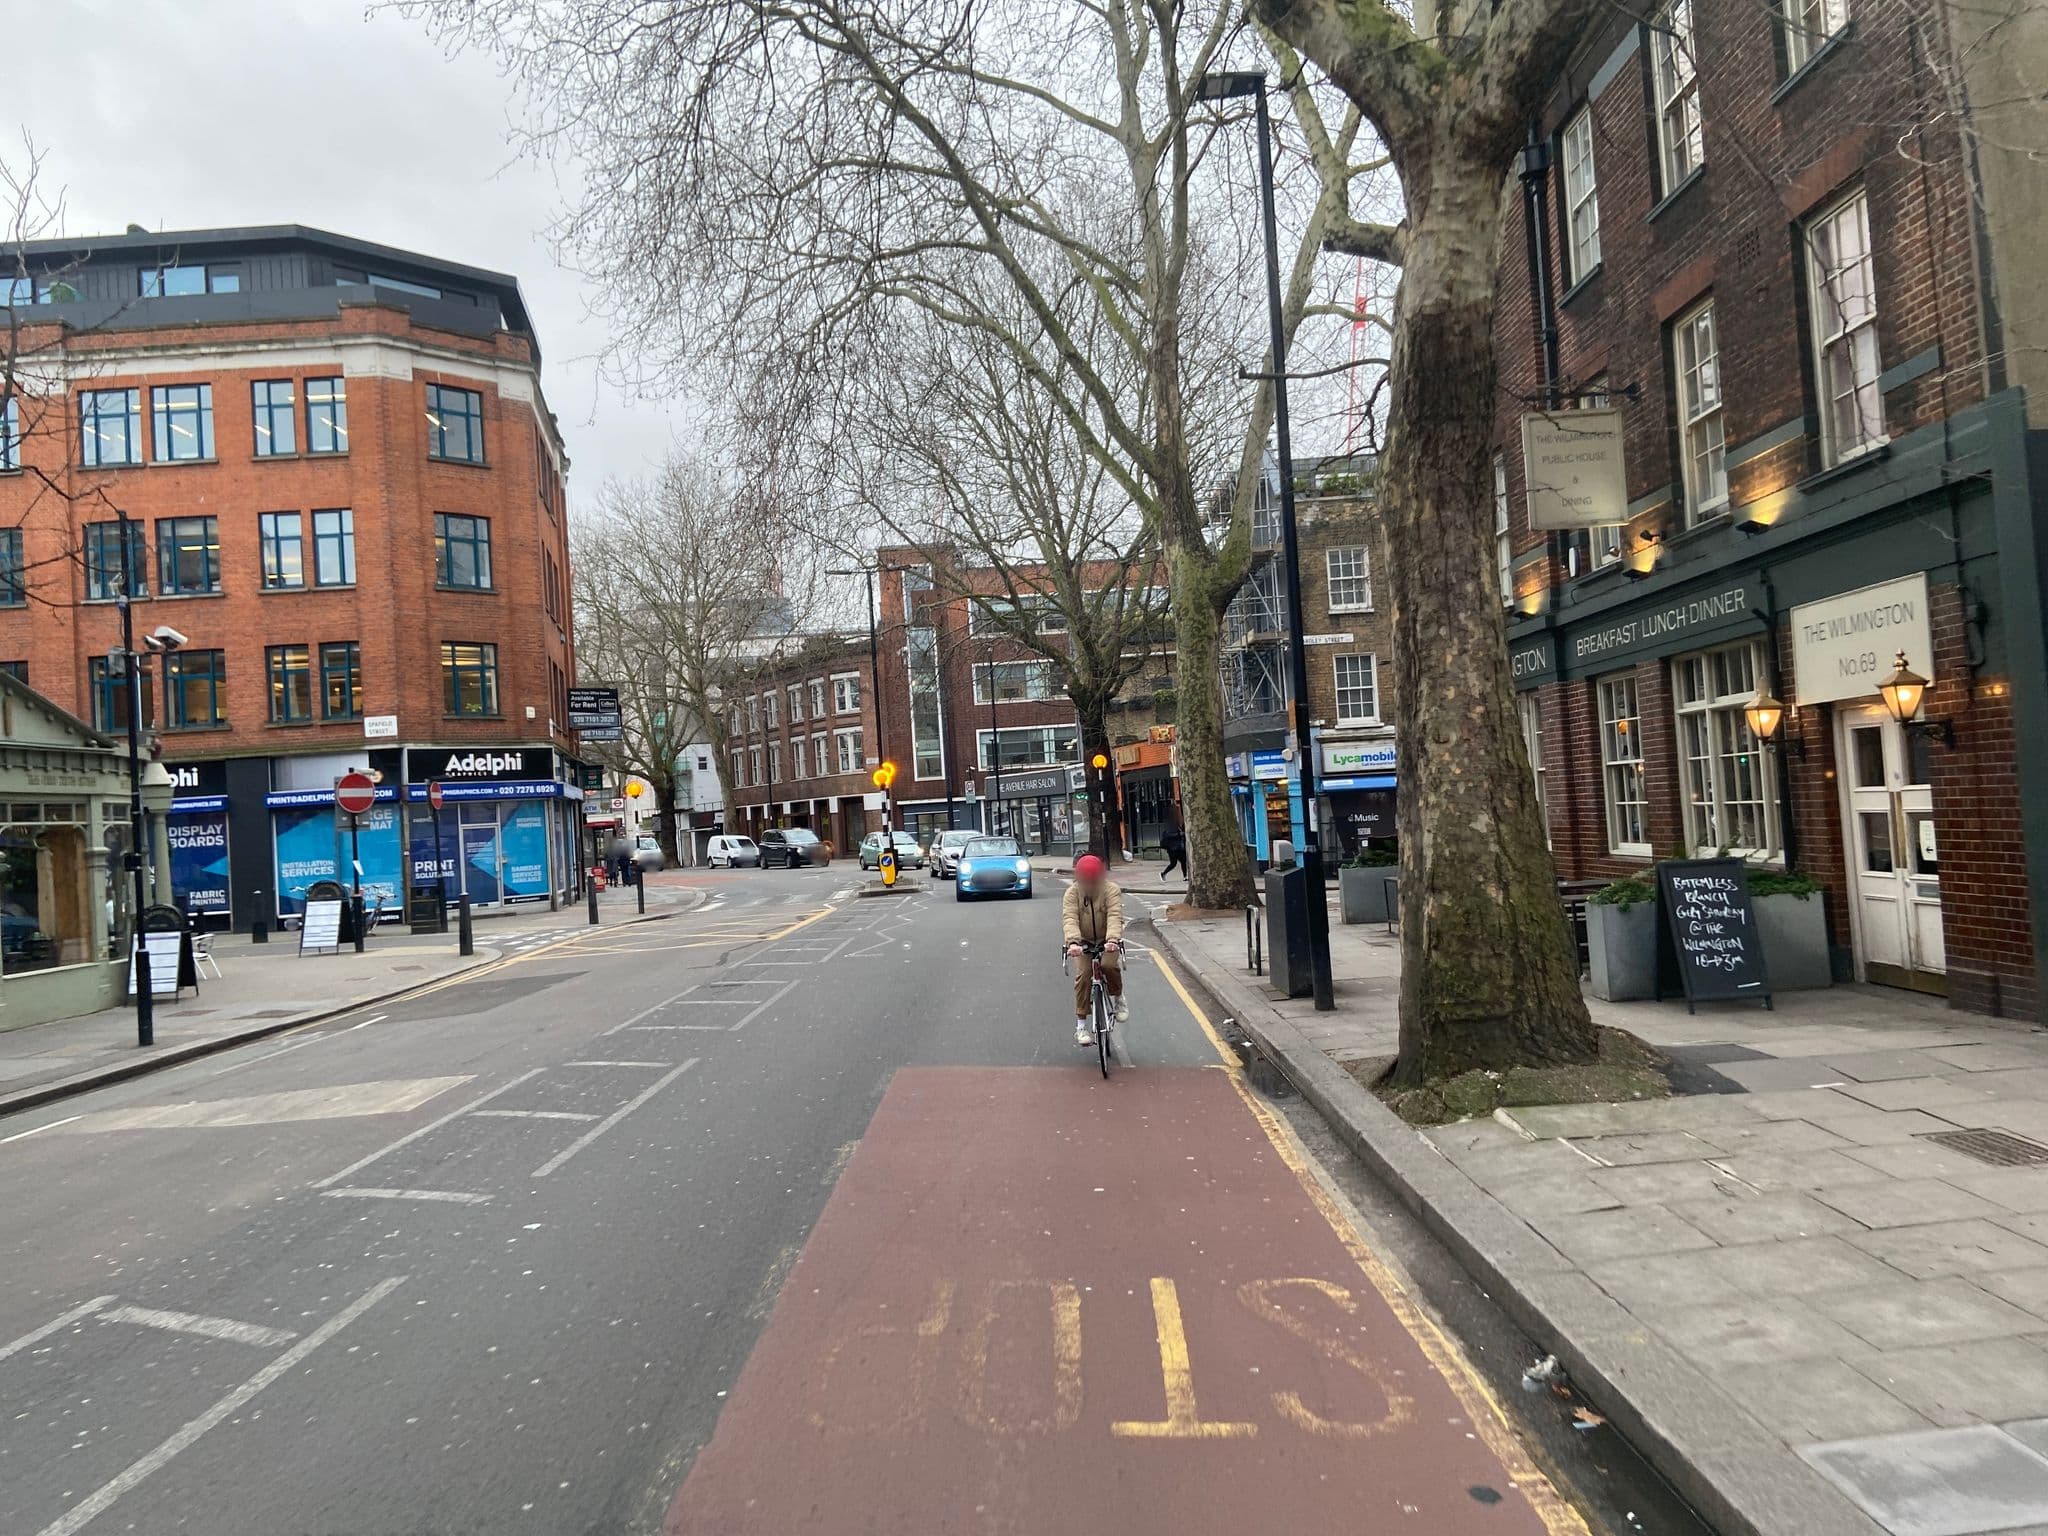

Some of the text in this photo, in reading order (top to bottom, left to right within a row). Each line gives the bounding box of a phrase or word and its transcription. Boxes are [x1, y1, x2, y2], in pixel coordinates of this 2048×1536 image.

[1541, 451, 1607, 464] PUBLIC HOUSE
[1561, 496, 1593, 507] DINING
[1576, 588, 1746, 657] BREAKFAST LUNCH DINNER
[1803, 601, 1914, 644] THE WILMINGTON
[445, 752, 522, 776] Adelphi
[499, 786, 514, 794] 020
[1005, 780, 1025, 792] AVENUE
[1025, 779, 1038, 790] HAIR
[1038, 777, 1056, 788] SALON
[584, 804, 598, 812] ATM
[1354, 813, 1380, 822] Music
[168, 824, 223, 838] DISPLAY
[170, 835, 225, 849] BOARDS
[281, 867, 335, 877] SERVICES
[189, 890, 226, 900] FABRIC
[190, 897, 226, 906] PRINTING
[1704, 922, 1726, 935] THE
[801, 1276, 1416, 1440] STOP
